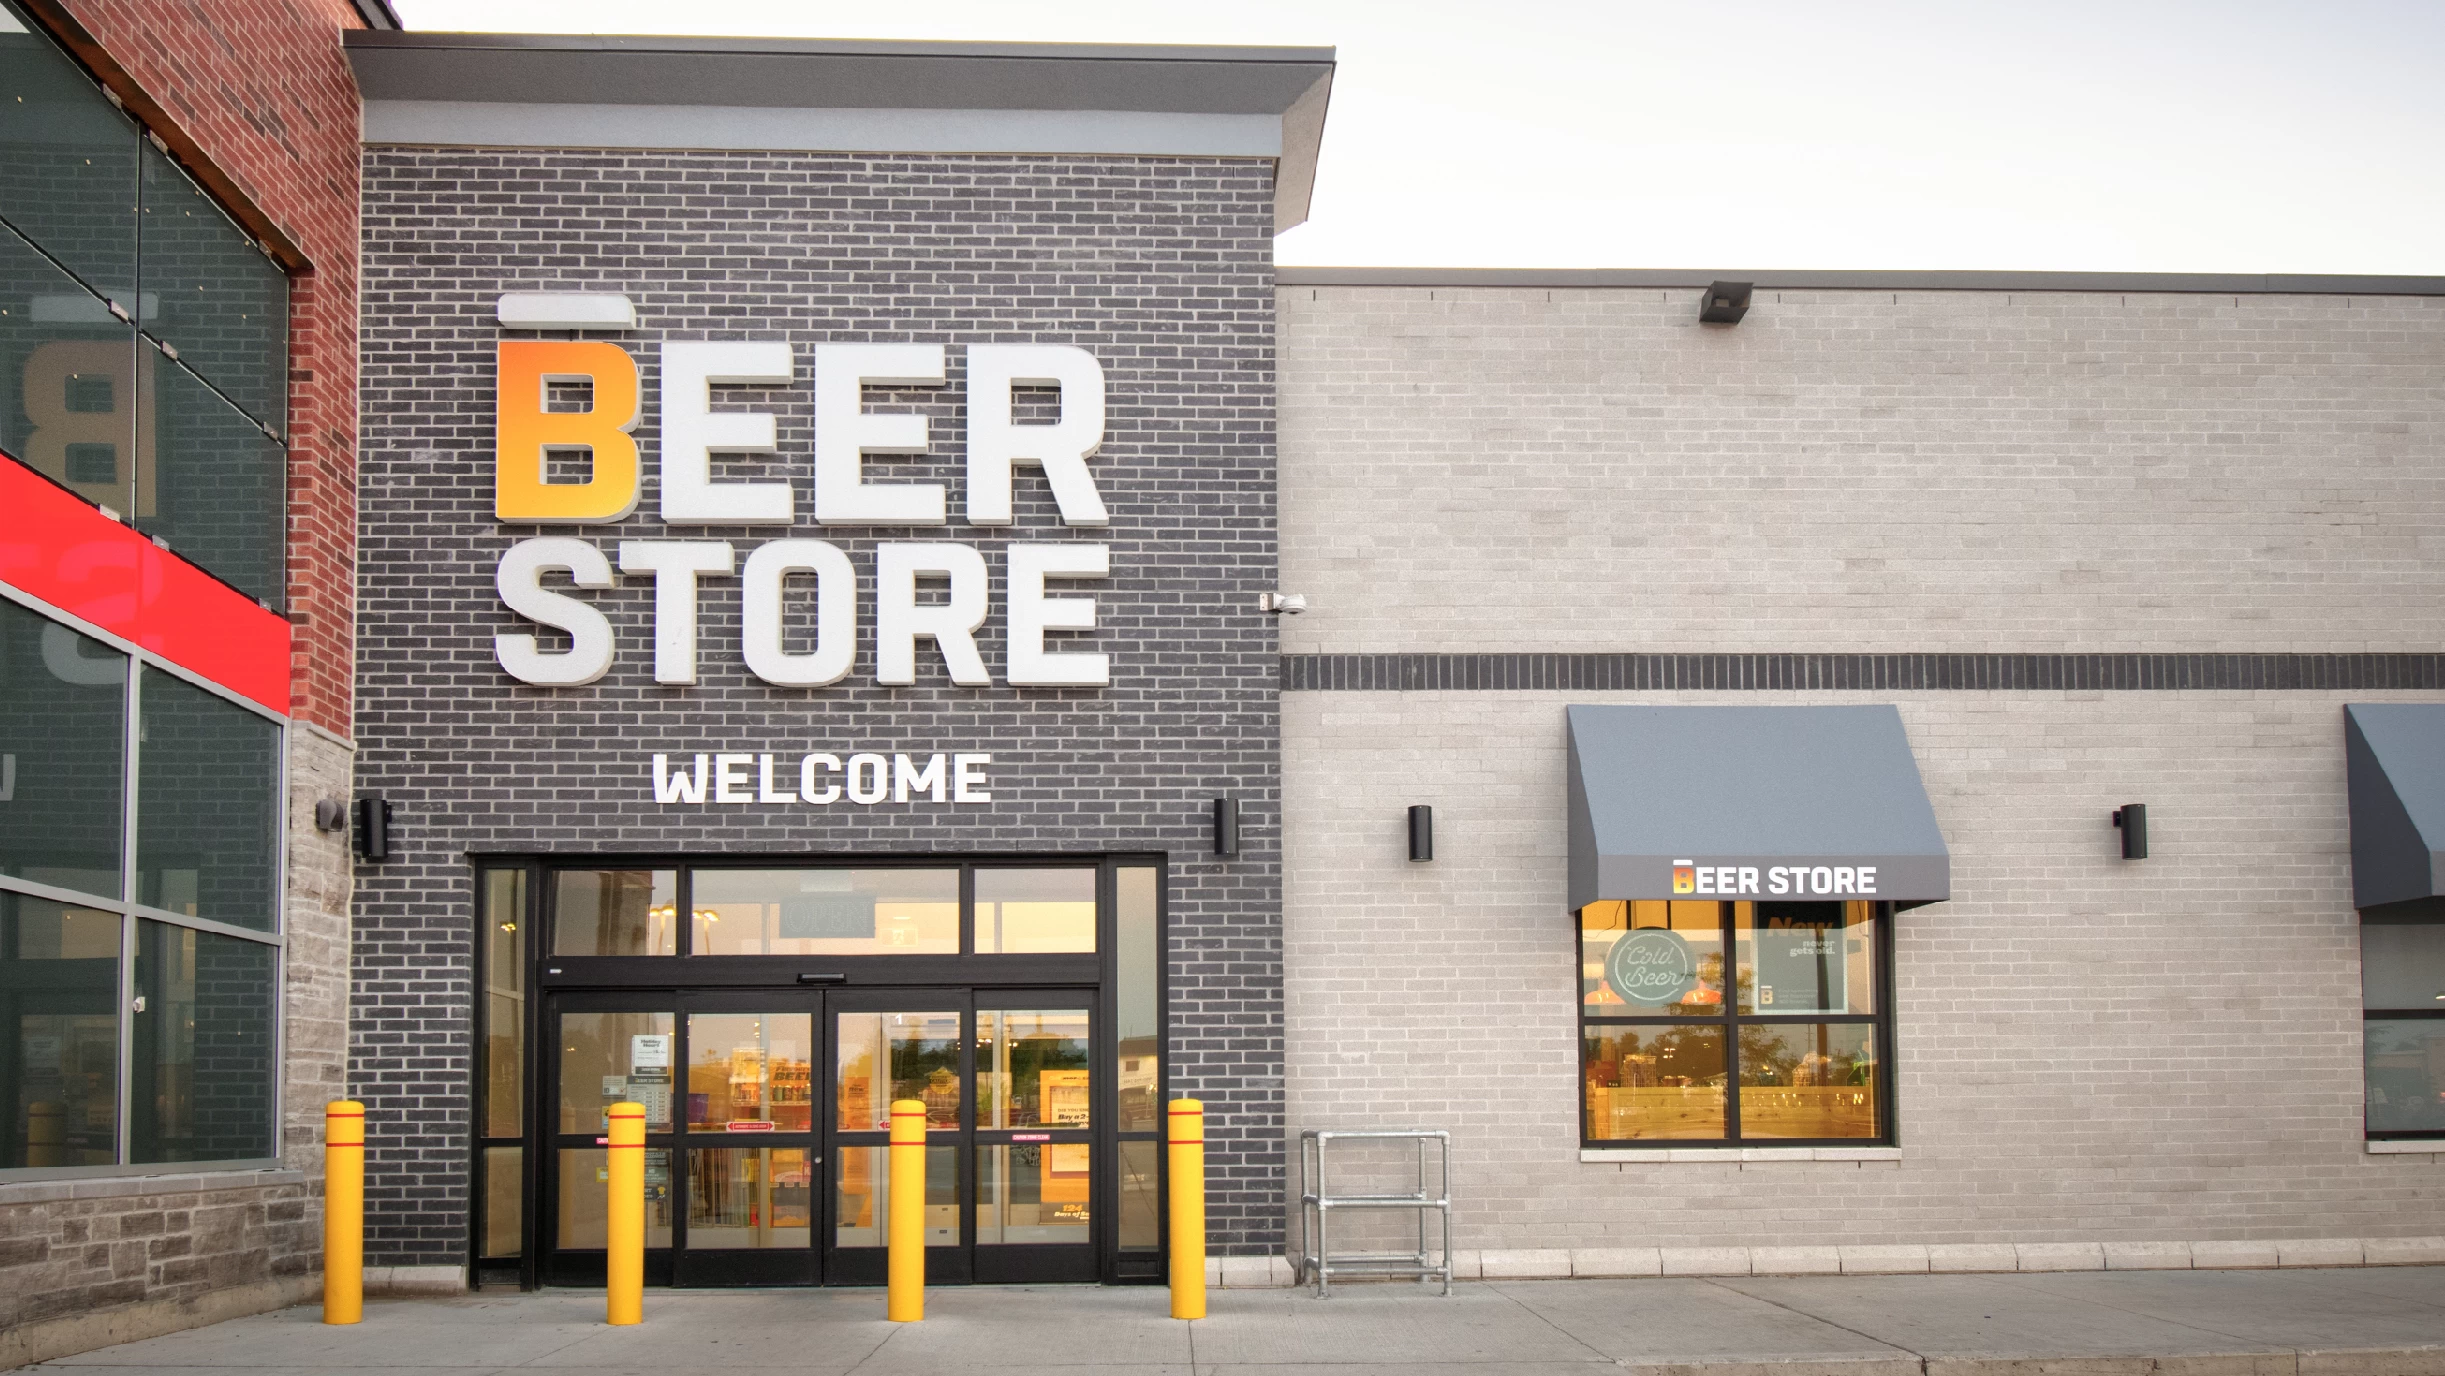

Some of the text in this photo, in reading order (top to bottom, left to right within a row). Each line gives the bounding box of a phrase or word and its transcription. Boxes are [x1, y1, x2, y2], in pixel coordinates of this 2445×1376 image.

[496, 338, 1110, 526] BEER
[496, 537, 1110, 688] STORE
[652, 752, 992, 805] WELCOME
[1672, 864, 1877, 895] BEER STORE
[1766, 917, 1834, 937] New
[1789, 946, 1814, 958] gets
[1625, 966, 1685, 988] Beer
[895, 1013, 903, 1025] 1
[1063, 1203, 1083, 1212] 124
